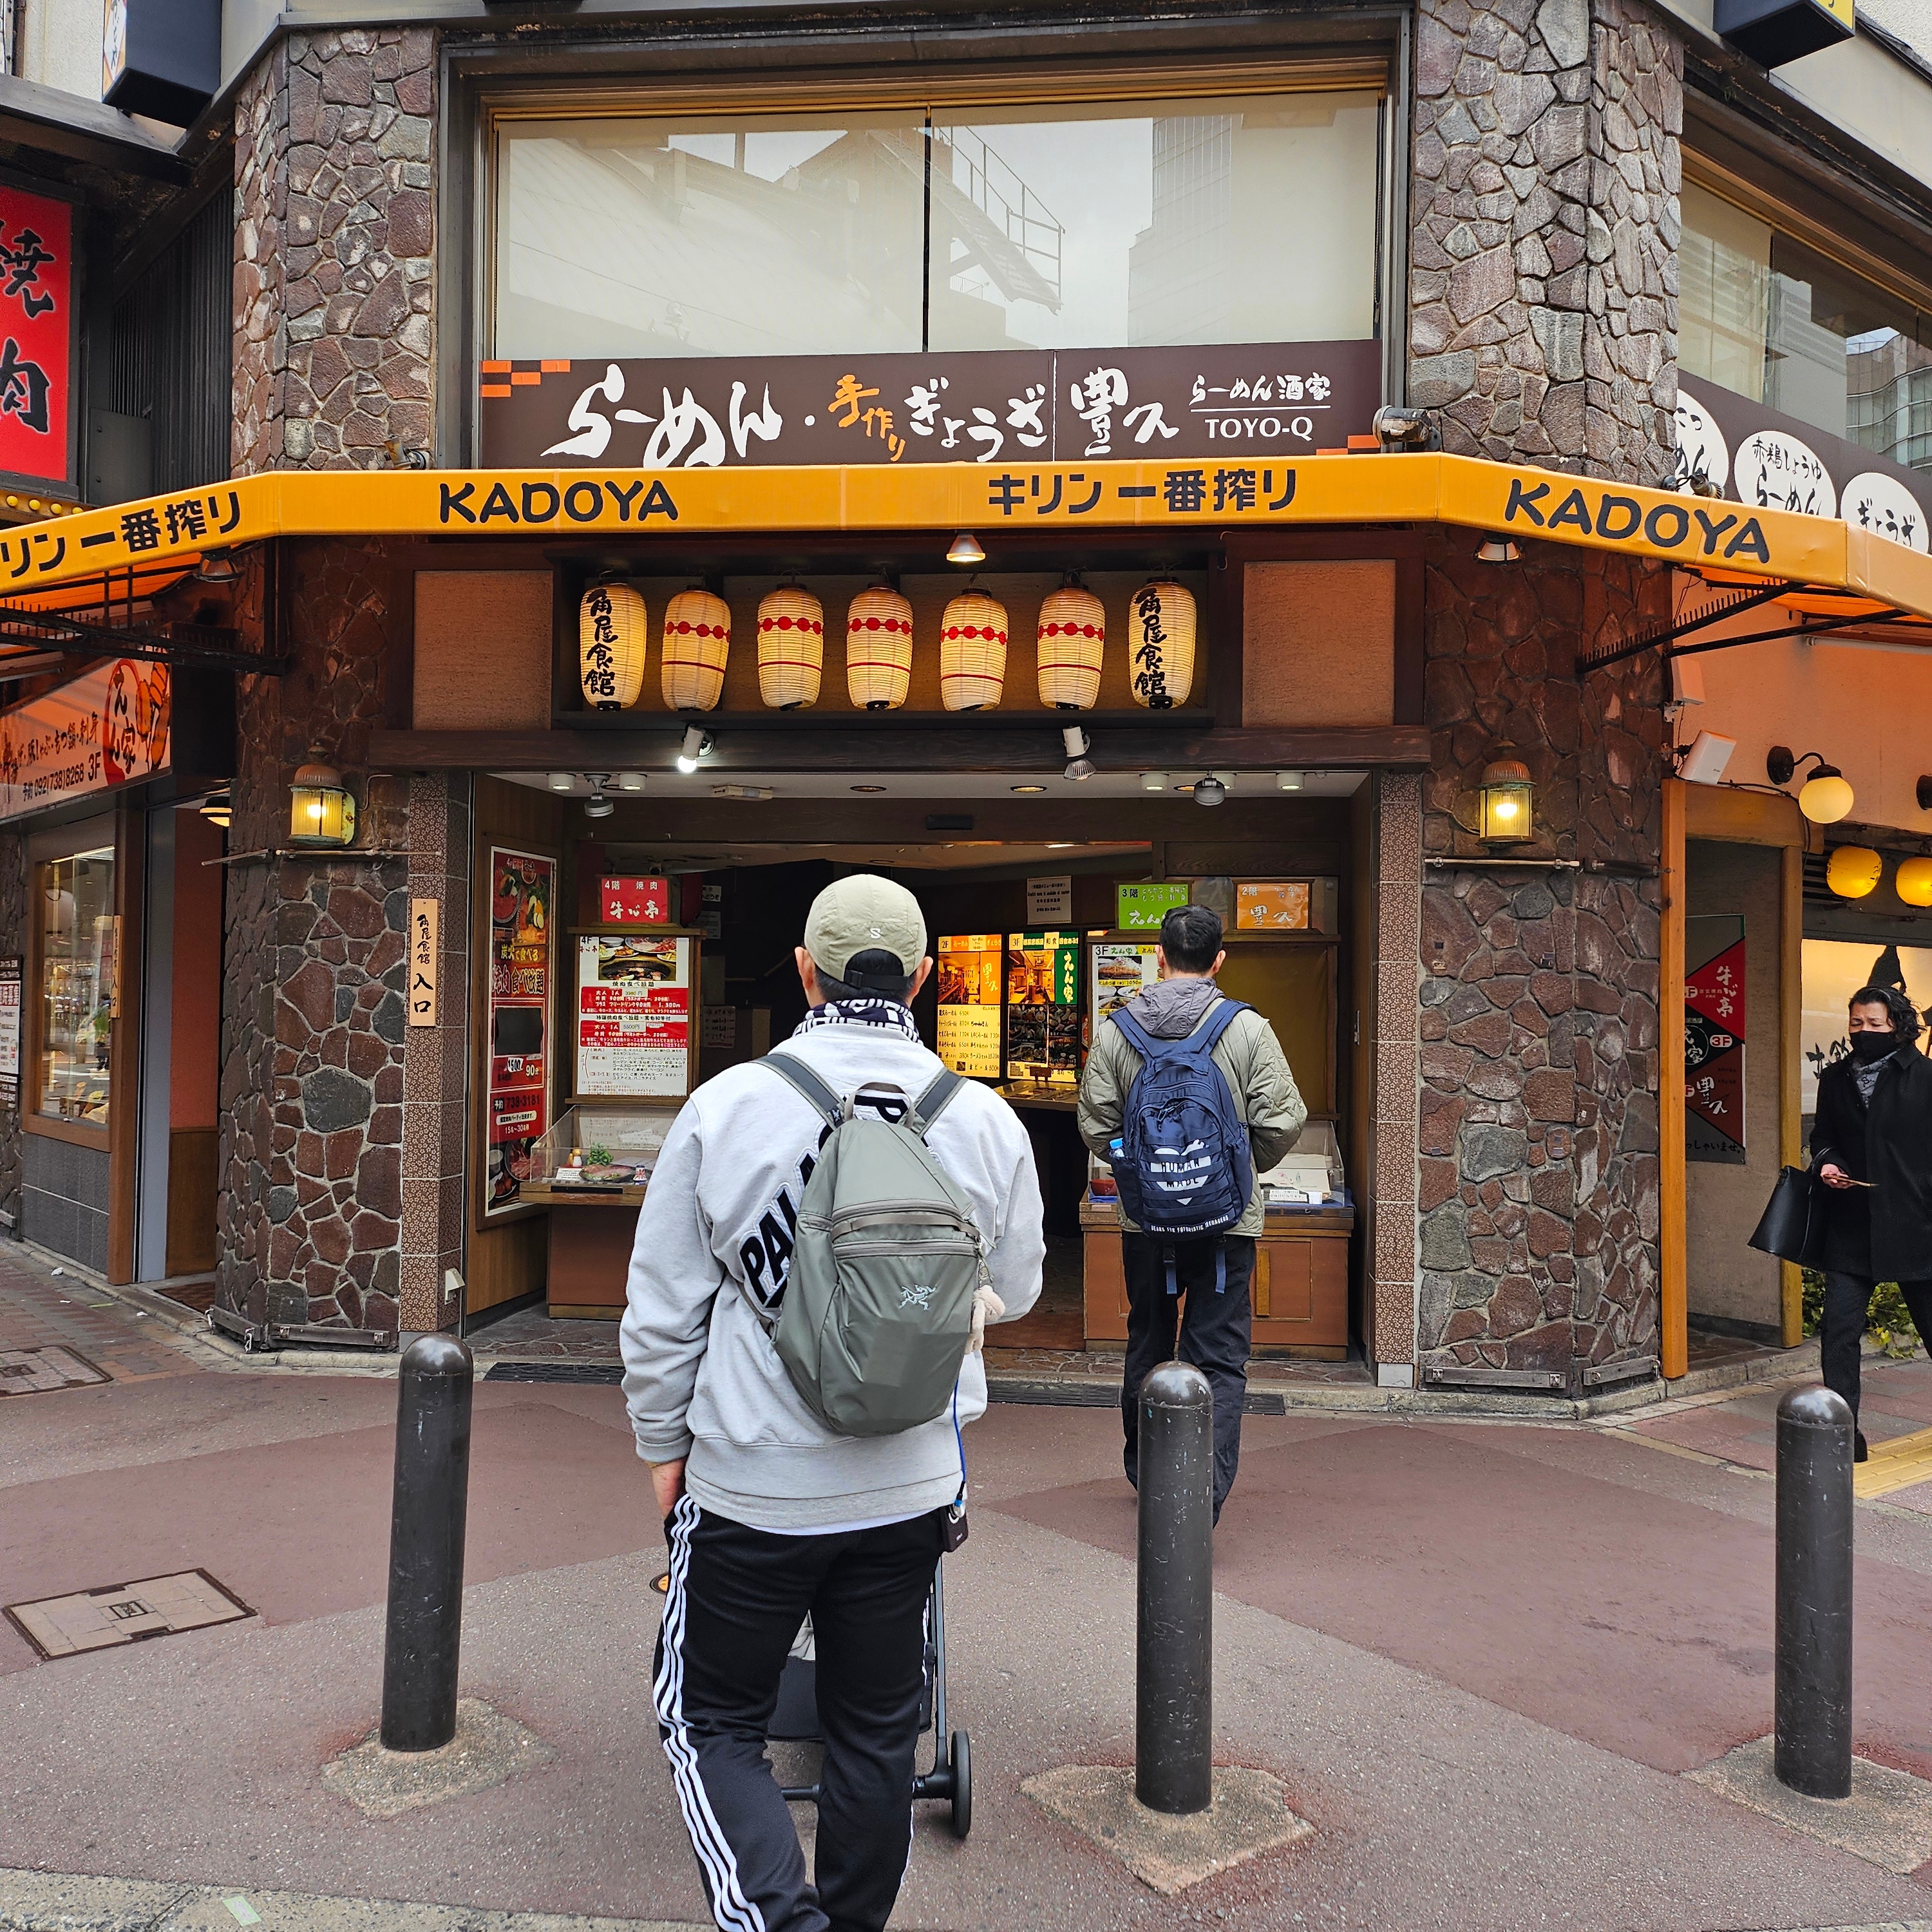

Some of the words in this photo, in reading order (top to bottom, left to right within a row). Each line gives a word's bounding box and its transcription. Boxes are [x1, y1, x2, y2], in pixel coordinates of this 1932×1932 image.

[1204, 416, 1313, 441] TOYO-Q
[440, 480, 679, 523] KADOYA
[989, 469, 1296, 515] キリン一番搾り
[1505, 478, 1770, 564] KADOYA
[584, 589, 618, 697] 角屋食館
[1134, 587, 1168, 696] 角屋食館
[88, 751, 102, 782] 3F
[605, 880, 620, 890] 4階
[1122, 888, 1139, 898] 3階
[1242, 886, 1258, 896] 2階
[610, 899, 659, 920] 牛心亭
[1128, 909, 1166, 925] えん
[416, 914, 432, 965] 角屋食館
[581, 936, 592, 945] 4F
[942, 940, 949, 949] 2F
[1012, 938, 1020, 947] 3F
[1095, 945, 1109, 955] 3F
[413, 972, 434, 1013] 入口
[1716, 965, 1738, 1018] 牛心亭
[1711, 1036, 1731, 1046] 3F
